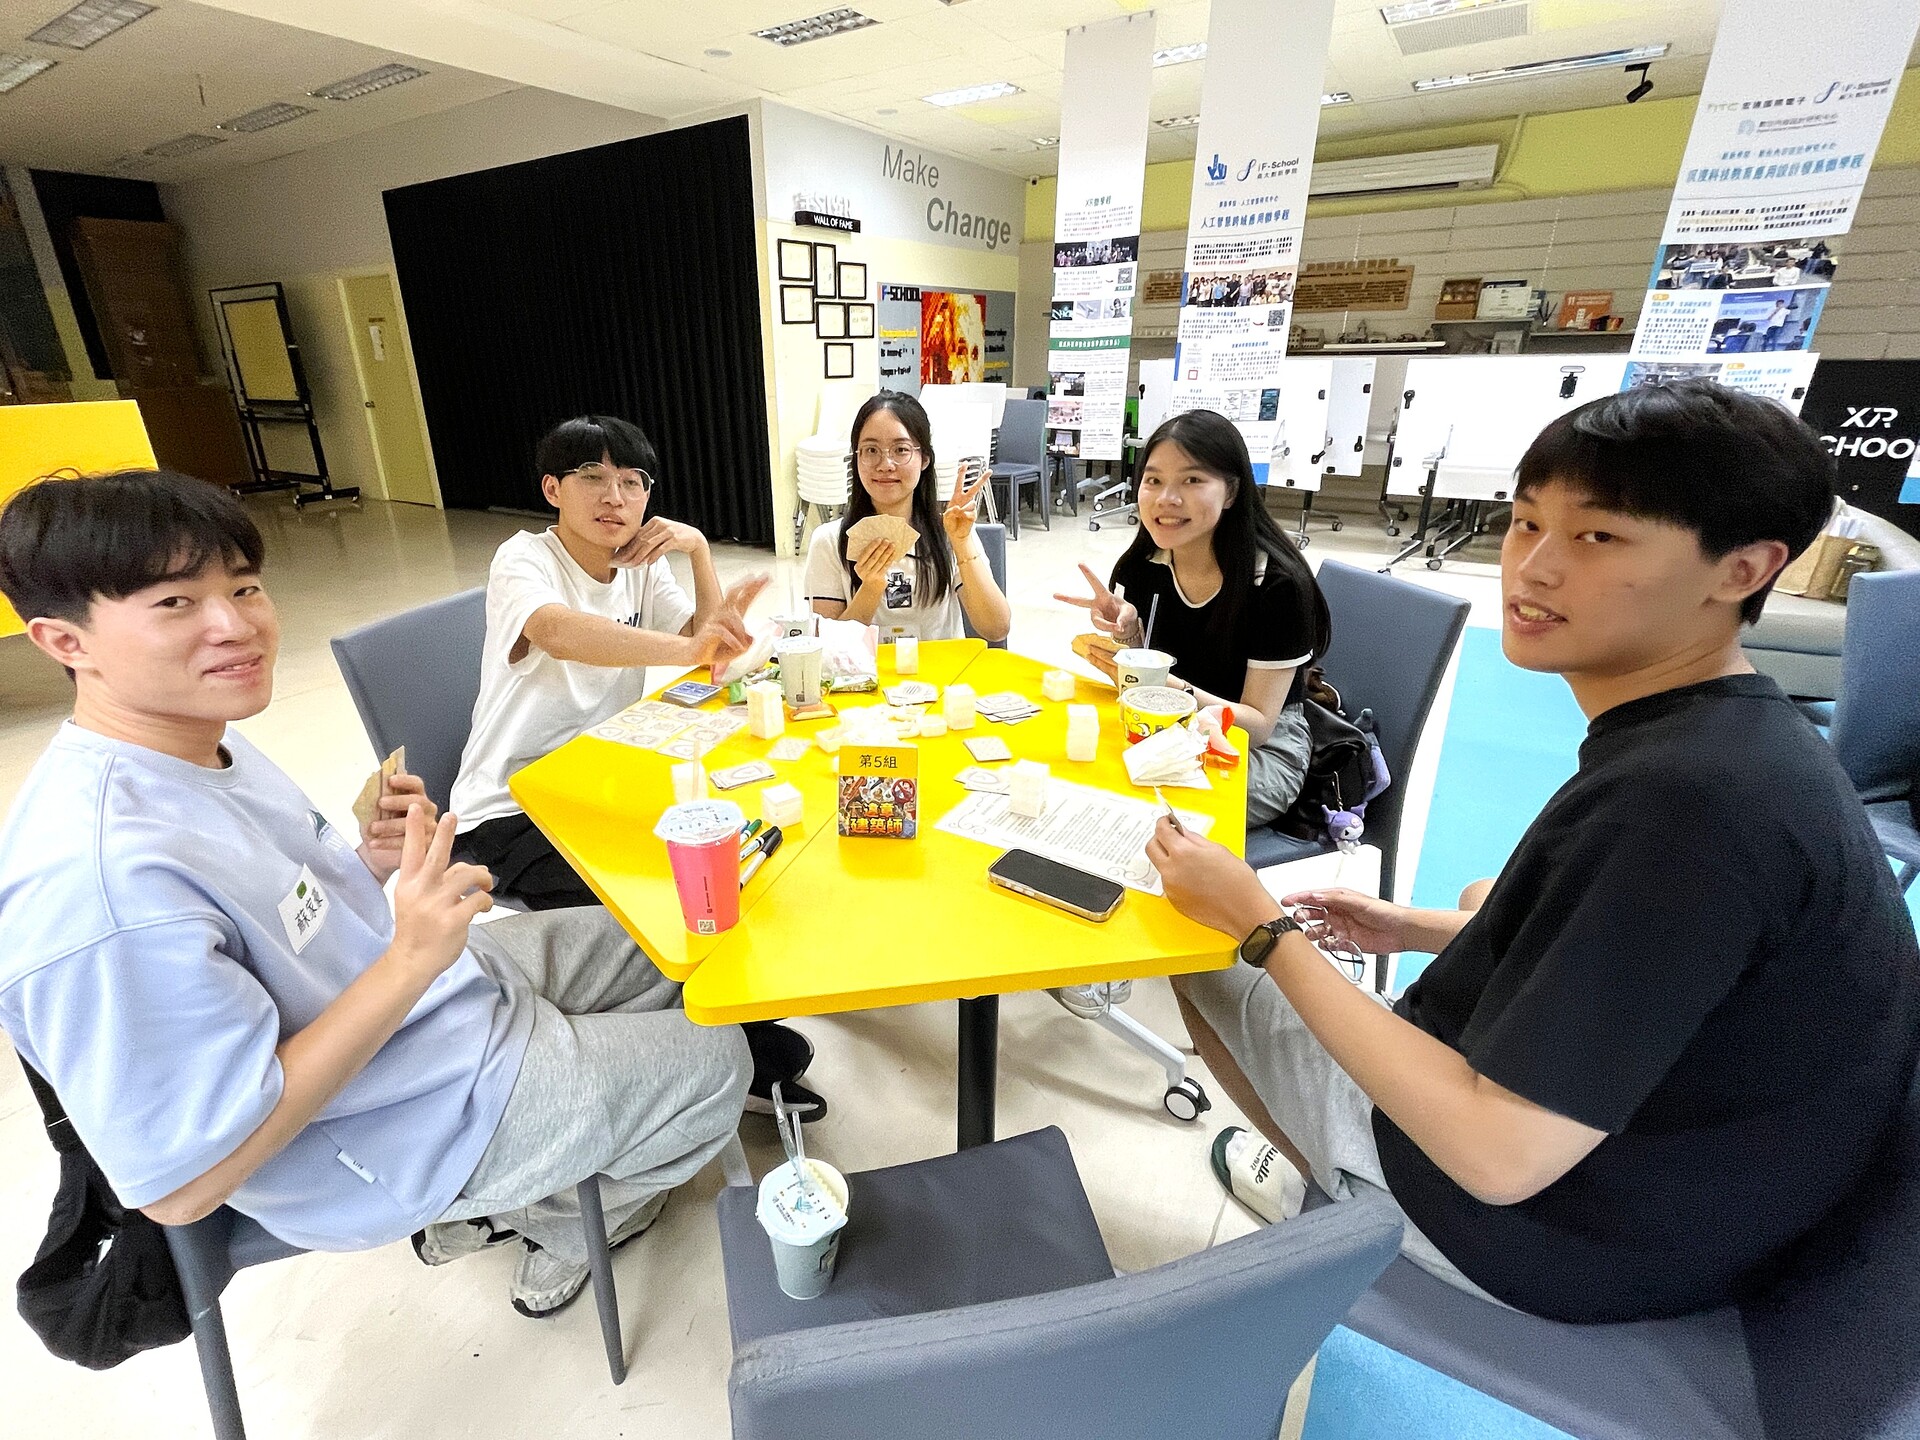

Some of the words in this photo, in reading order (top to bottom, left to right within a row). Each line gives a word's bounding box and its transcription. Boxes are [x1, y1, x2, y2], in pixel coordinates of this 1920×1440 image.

[882, 145, 940, 188] Make
[813, 215, 830, 226] WALL
[830, 218, 838, 227] OF
[839, 220, 853, 230] FAME
[927, 197, 1011, 250] Change
[859, 754, 898, 769] 第5組
[850, 817, 903, 834] 建築師
